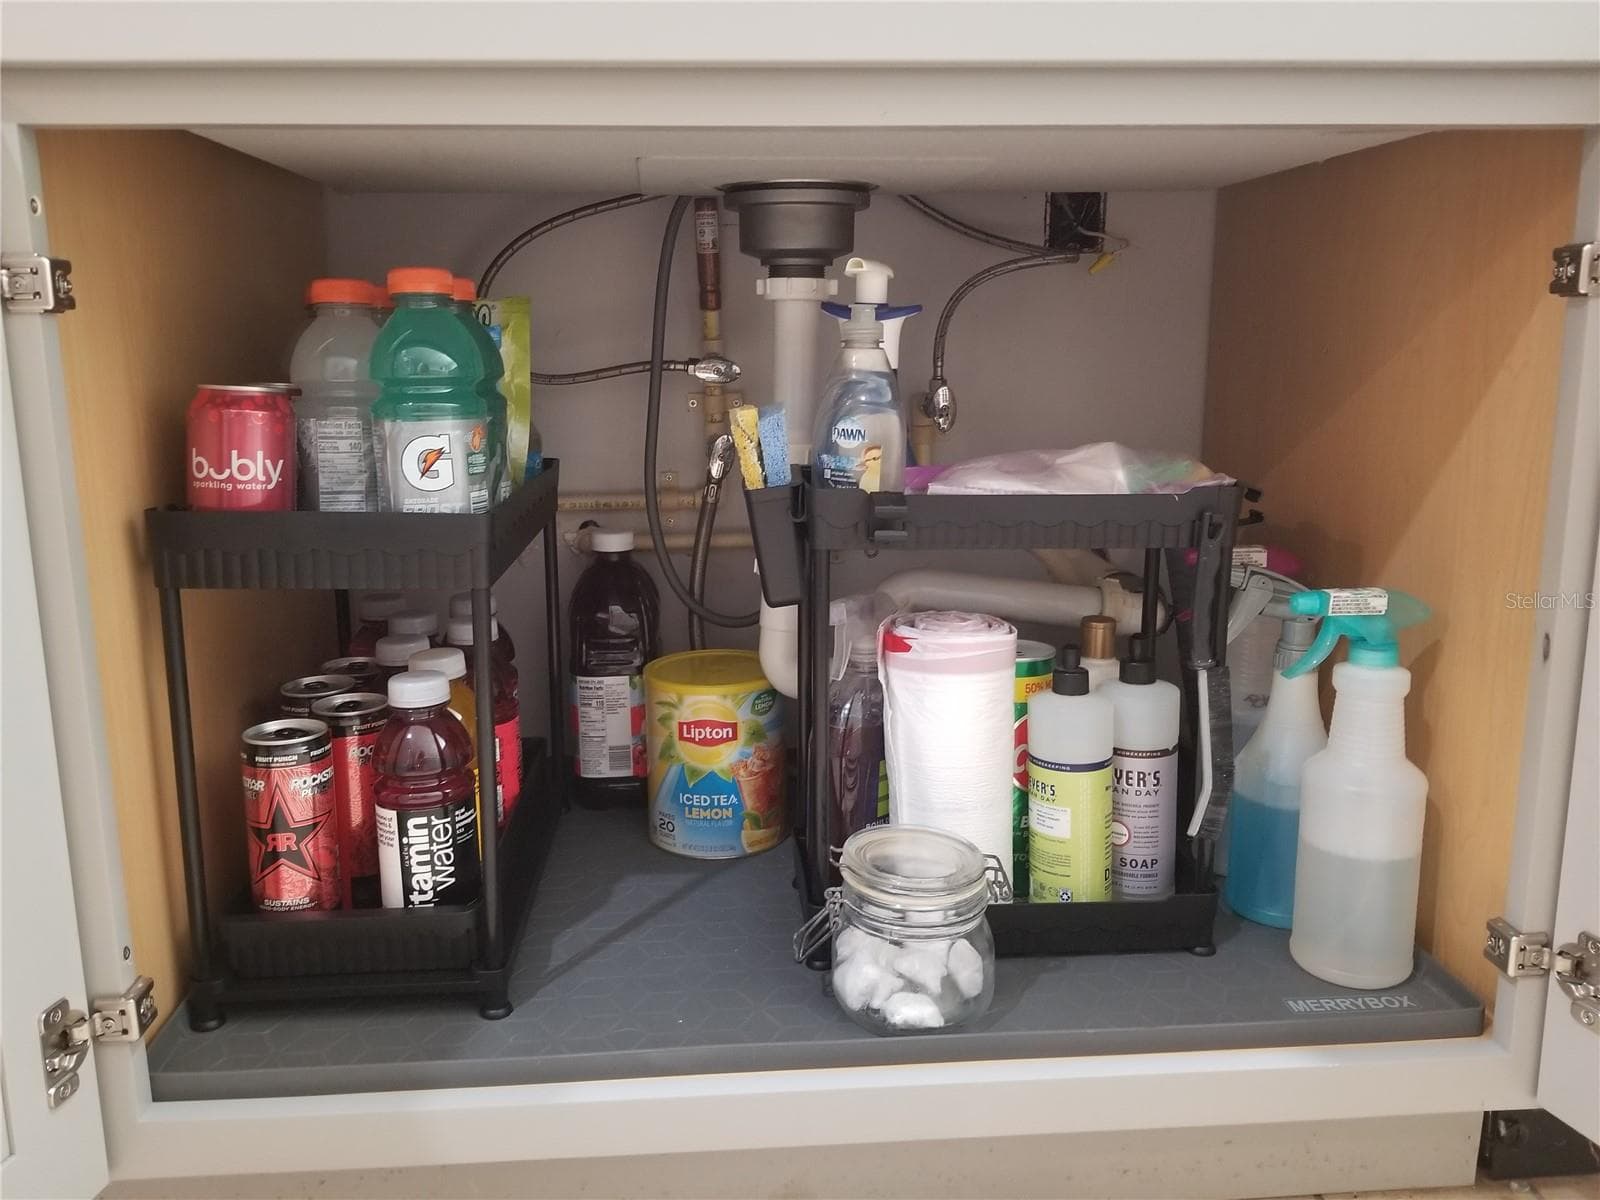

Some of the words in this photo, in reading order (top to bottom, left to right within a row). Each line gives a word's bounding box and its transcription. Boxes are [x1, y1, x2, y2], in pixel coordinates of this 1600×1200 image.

[833, 427, 866, 441] DAWN
[192, 447, 284, 490] bubly
[401, 433, 454, 492] G
[193, 480, 232, 492] sparkling
[683, 724, 733, 742] Lipton
[255, 755, 273, 763] FRUIT
[273, 754, 298, 763] PUNCH
[679, 792, 711, 806] ICED
[711, 794, 739, 806] TEA
[1134, 789, 1160, 797] DAY
[684, 806, 733, 820] LEMON
[658, 817, 675, 833] 20
[430, 815, 456, 892] water
[1119, 857, 1159, 870] SOAP
[264, 896, 310, 907] SUSTAINS
[1286, 995, 1417, 1012] MERRYBOX
